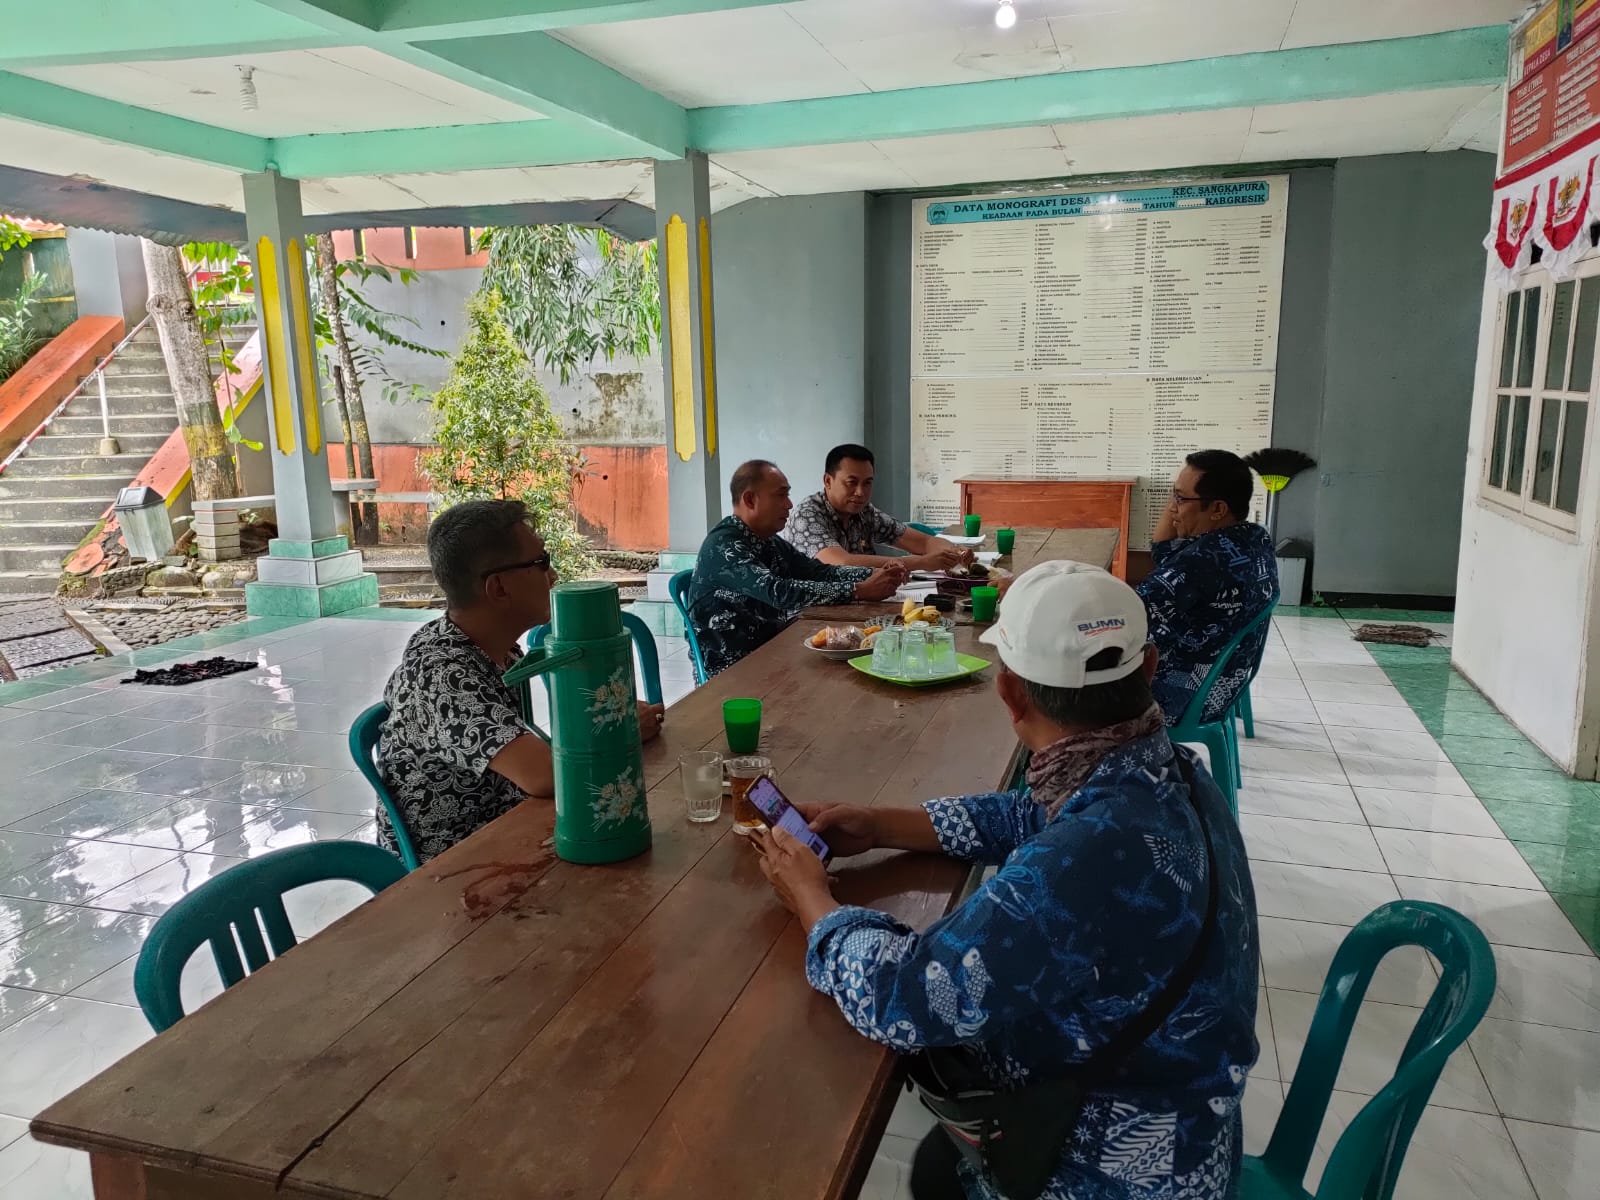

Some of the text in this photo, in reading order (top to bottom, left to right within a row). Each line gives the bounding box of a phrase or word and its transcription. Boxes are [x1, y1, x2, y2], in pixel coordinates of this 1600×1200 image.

[1173, 182, 1265, 196] KEC. SANGKAPURA
[953, 196, 1092, 213] DATA MONOGRAFI DESA
[982, 212, 1023, 220] KEADAAN
[1051, 207, 1081, 216] BULAN
[1143, 201, 1176, 210] TAHUN
[1077, 618, 1126, 632] BUMN
